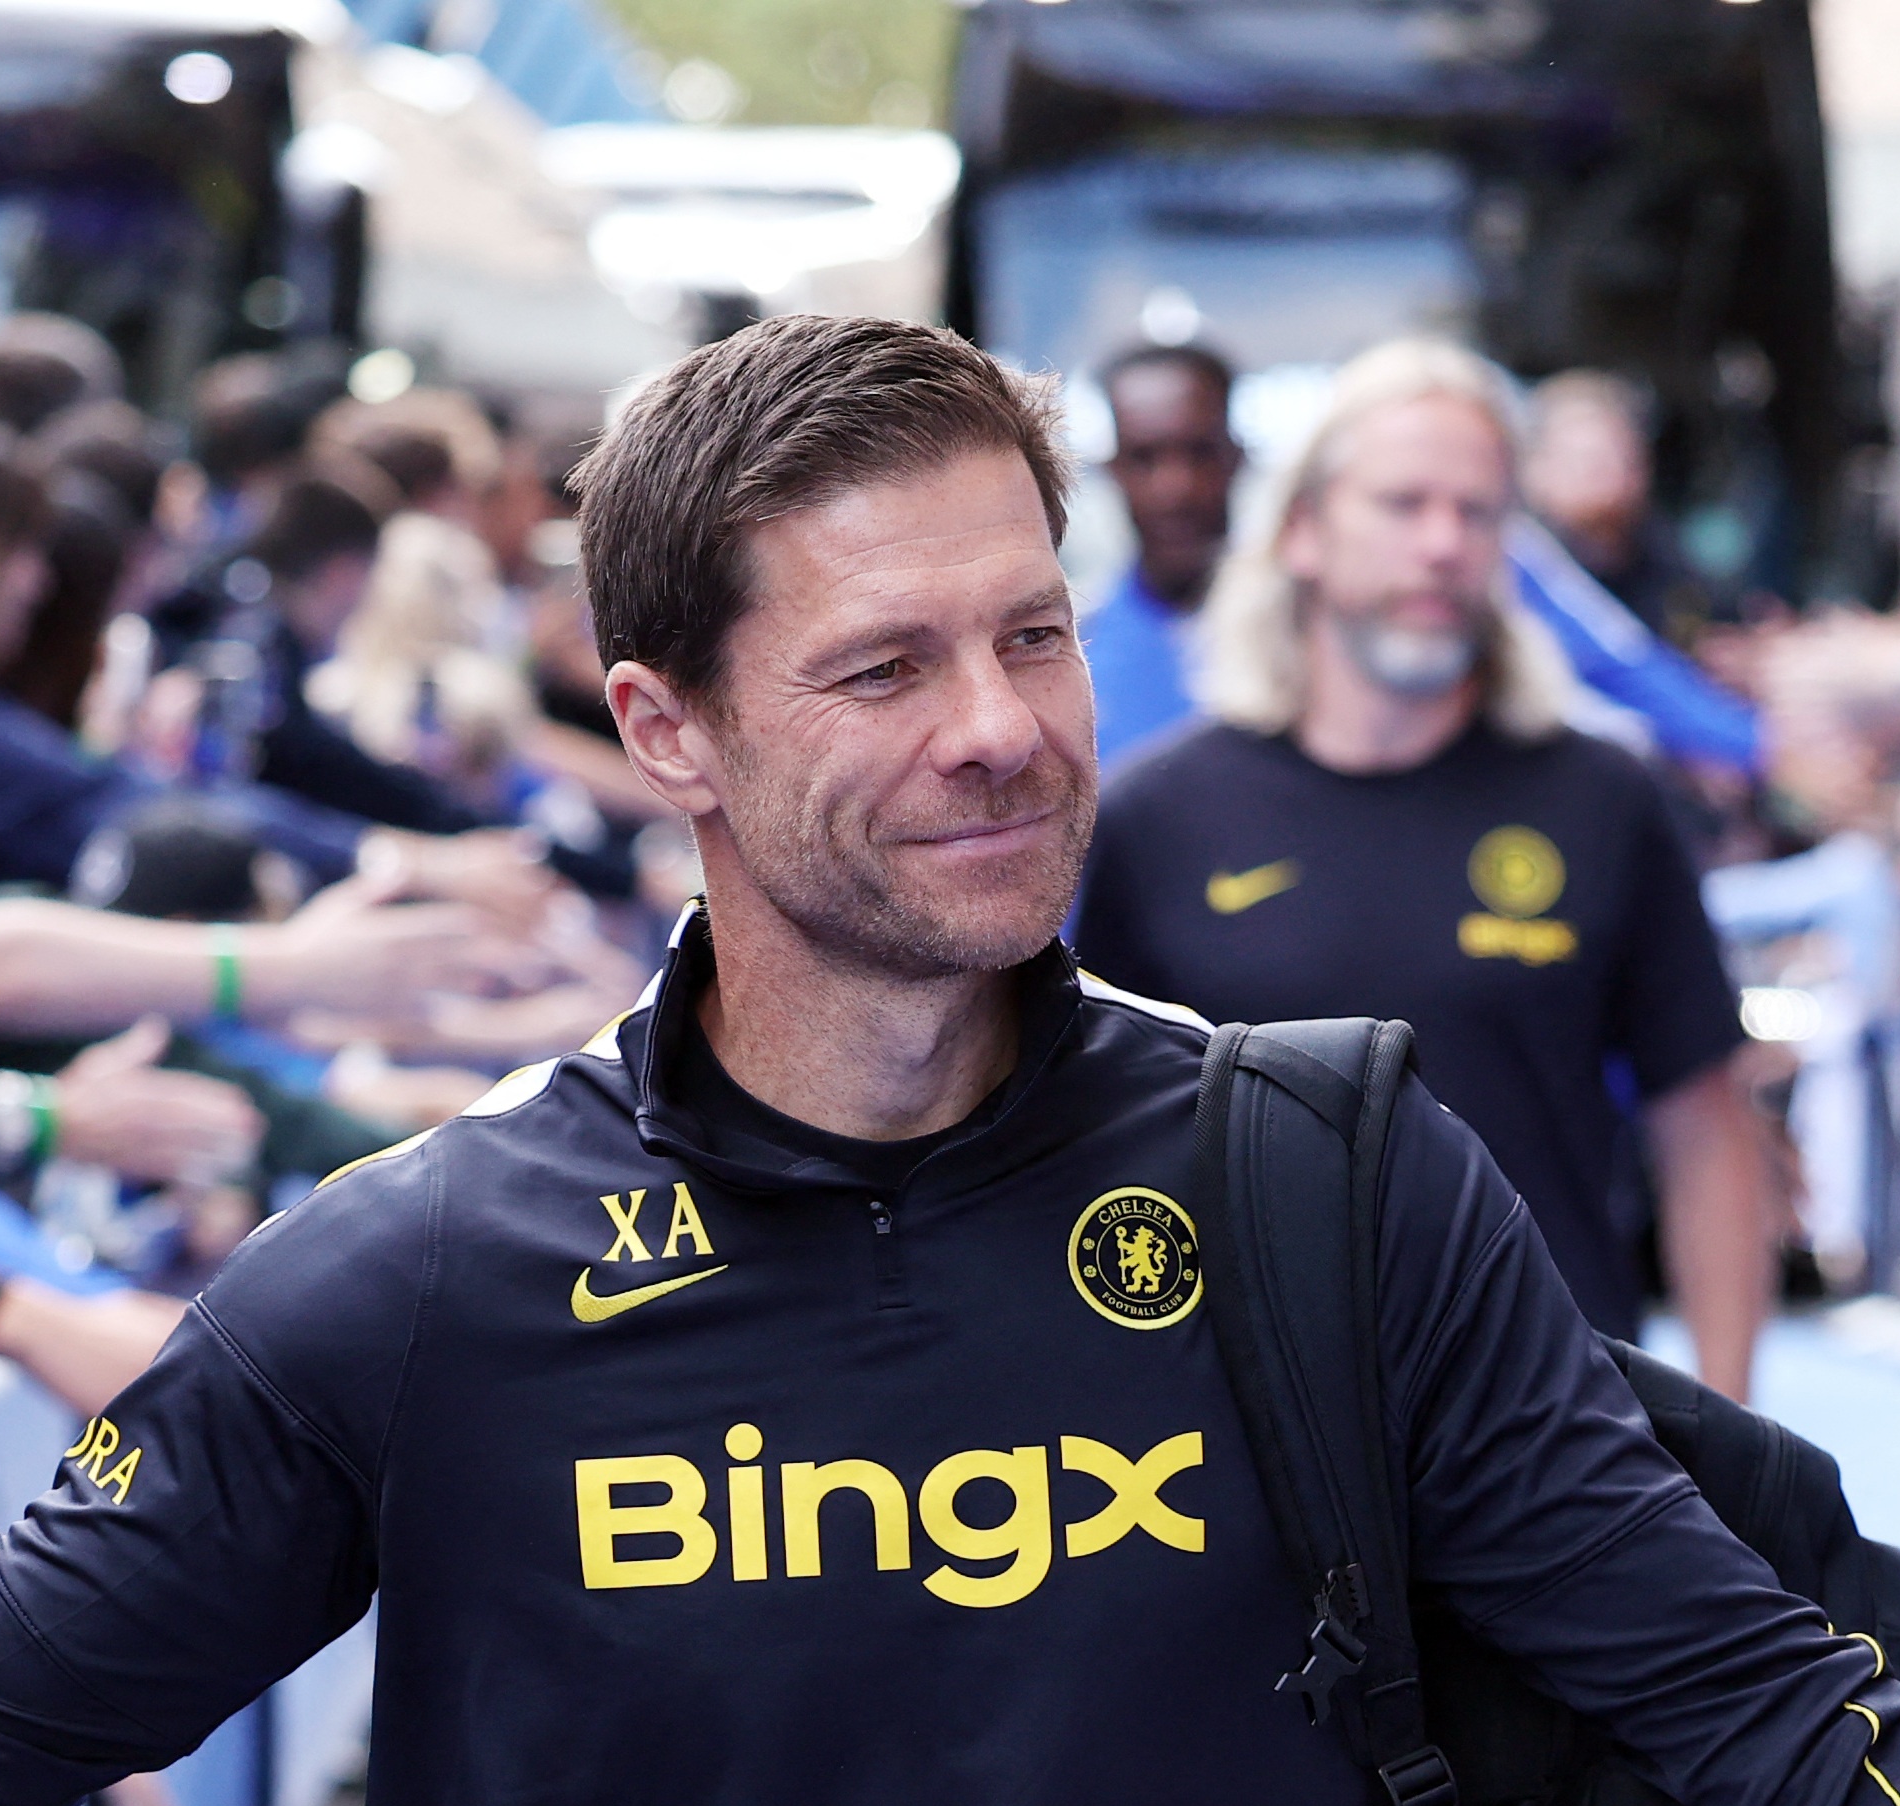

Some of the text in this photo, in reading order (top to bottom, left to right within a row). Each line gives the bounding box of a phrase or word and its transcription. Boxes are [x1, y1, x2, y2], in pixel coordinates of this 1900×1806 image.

[599, 1182, 715, 1263] XA
[1098, 1200, 1173, 1228] CHELSEA
[1102, 1291, 1183, 1316] FOOTBALL CLUB
